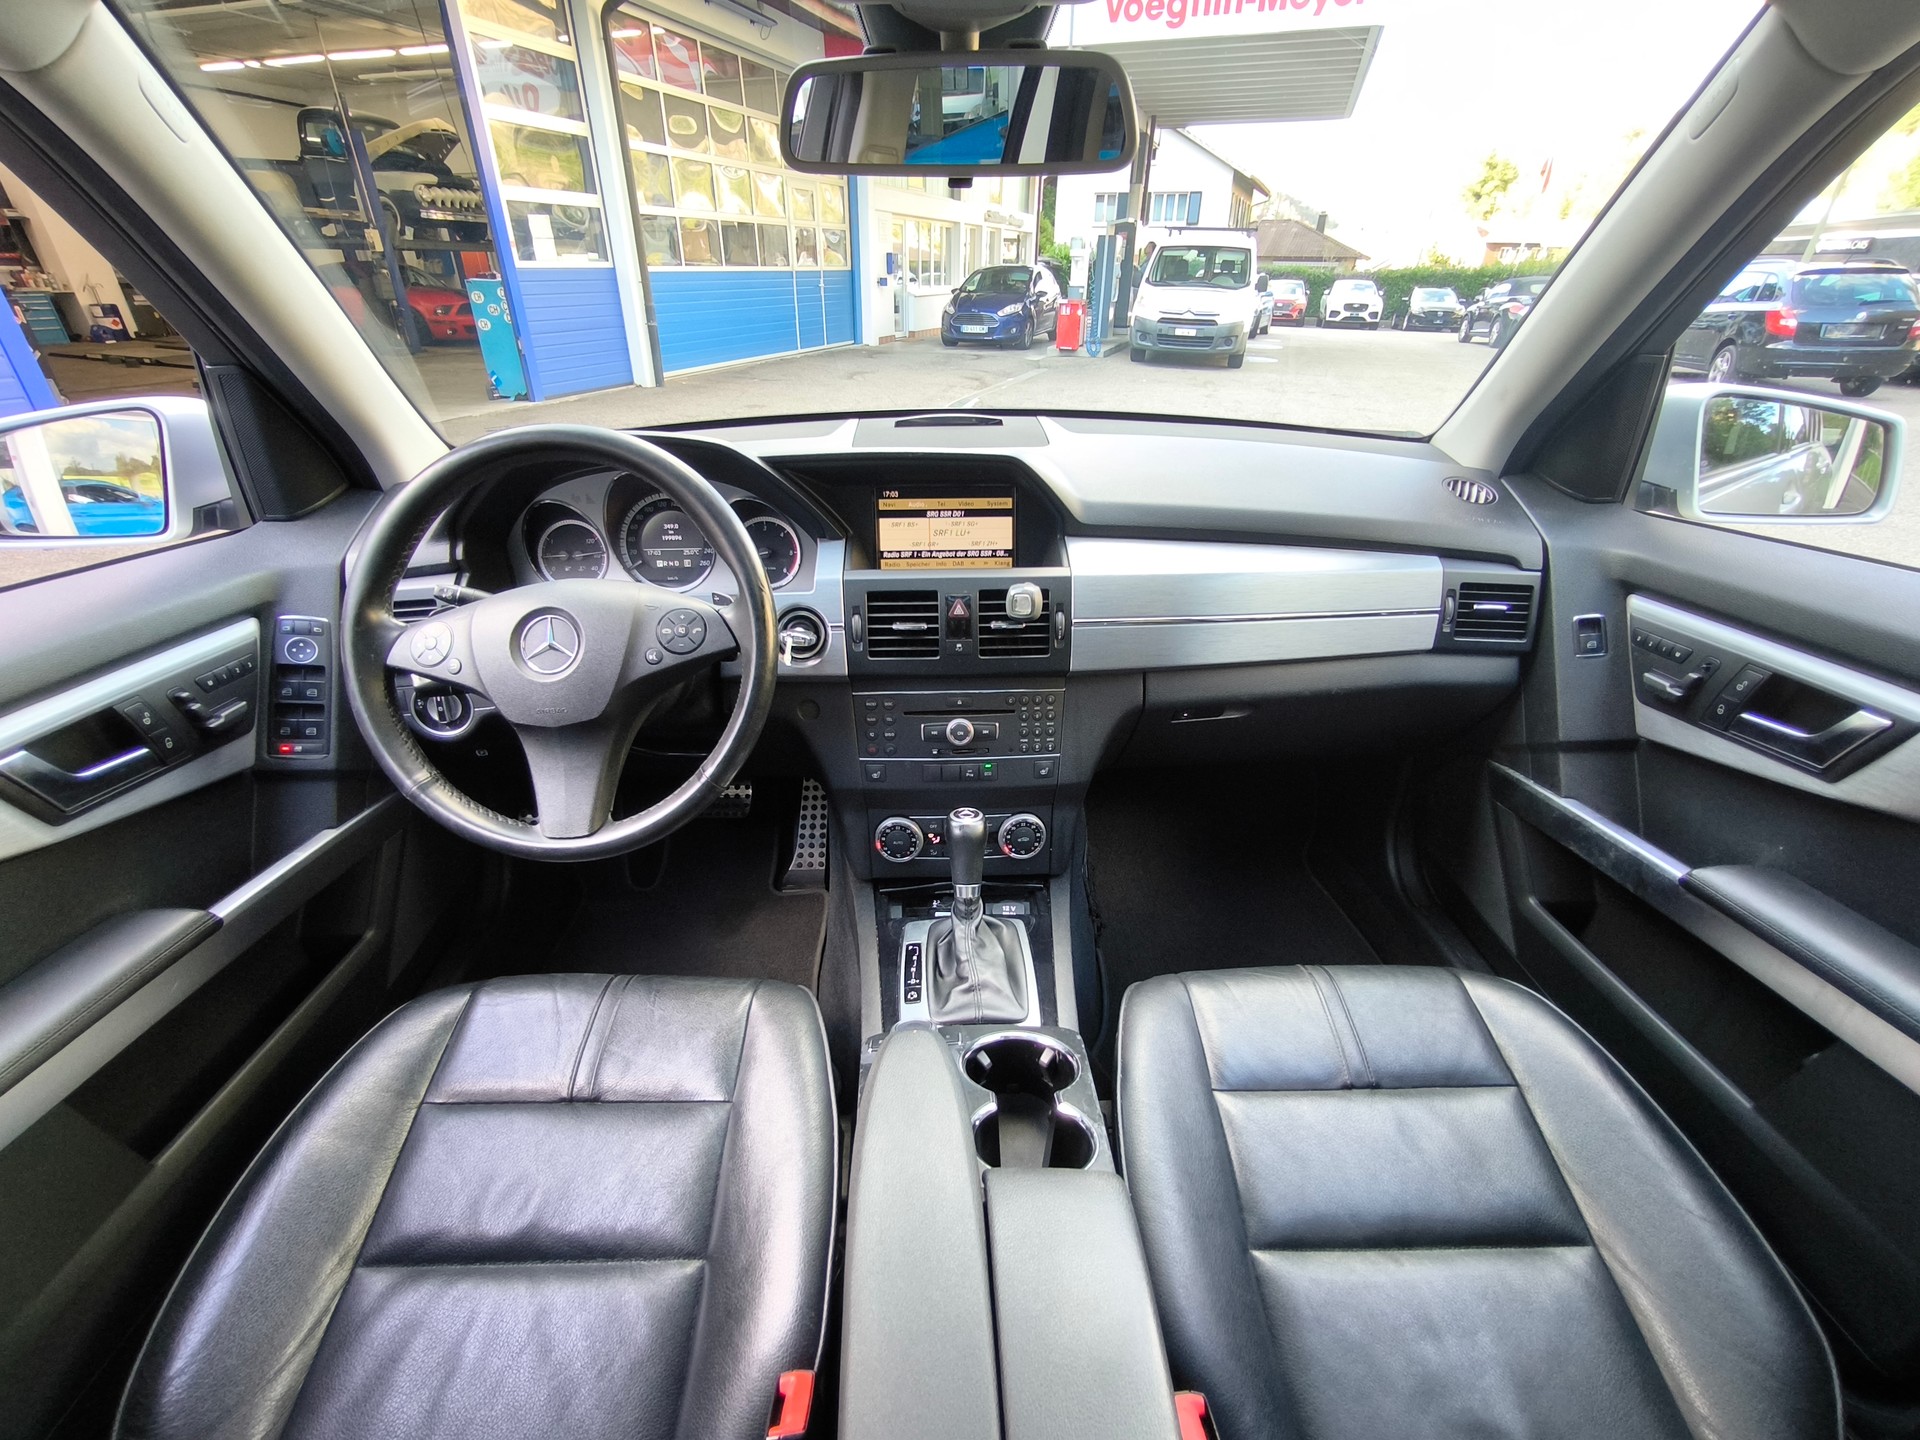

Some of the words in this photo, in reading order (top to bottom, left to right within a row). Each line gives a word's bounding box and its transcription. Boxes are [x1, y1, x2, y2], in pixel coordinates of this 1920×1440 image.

[473, 292, 483, 302] CH
[489, 305, 499, 314] CH
[480, 320, 489, 330] CH
[986, 500, 1009, 508] System
[933, 529, 949, 537] SRF
[931, 550, 956, 559] Angebot
